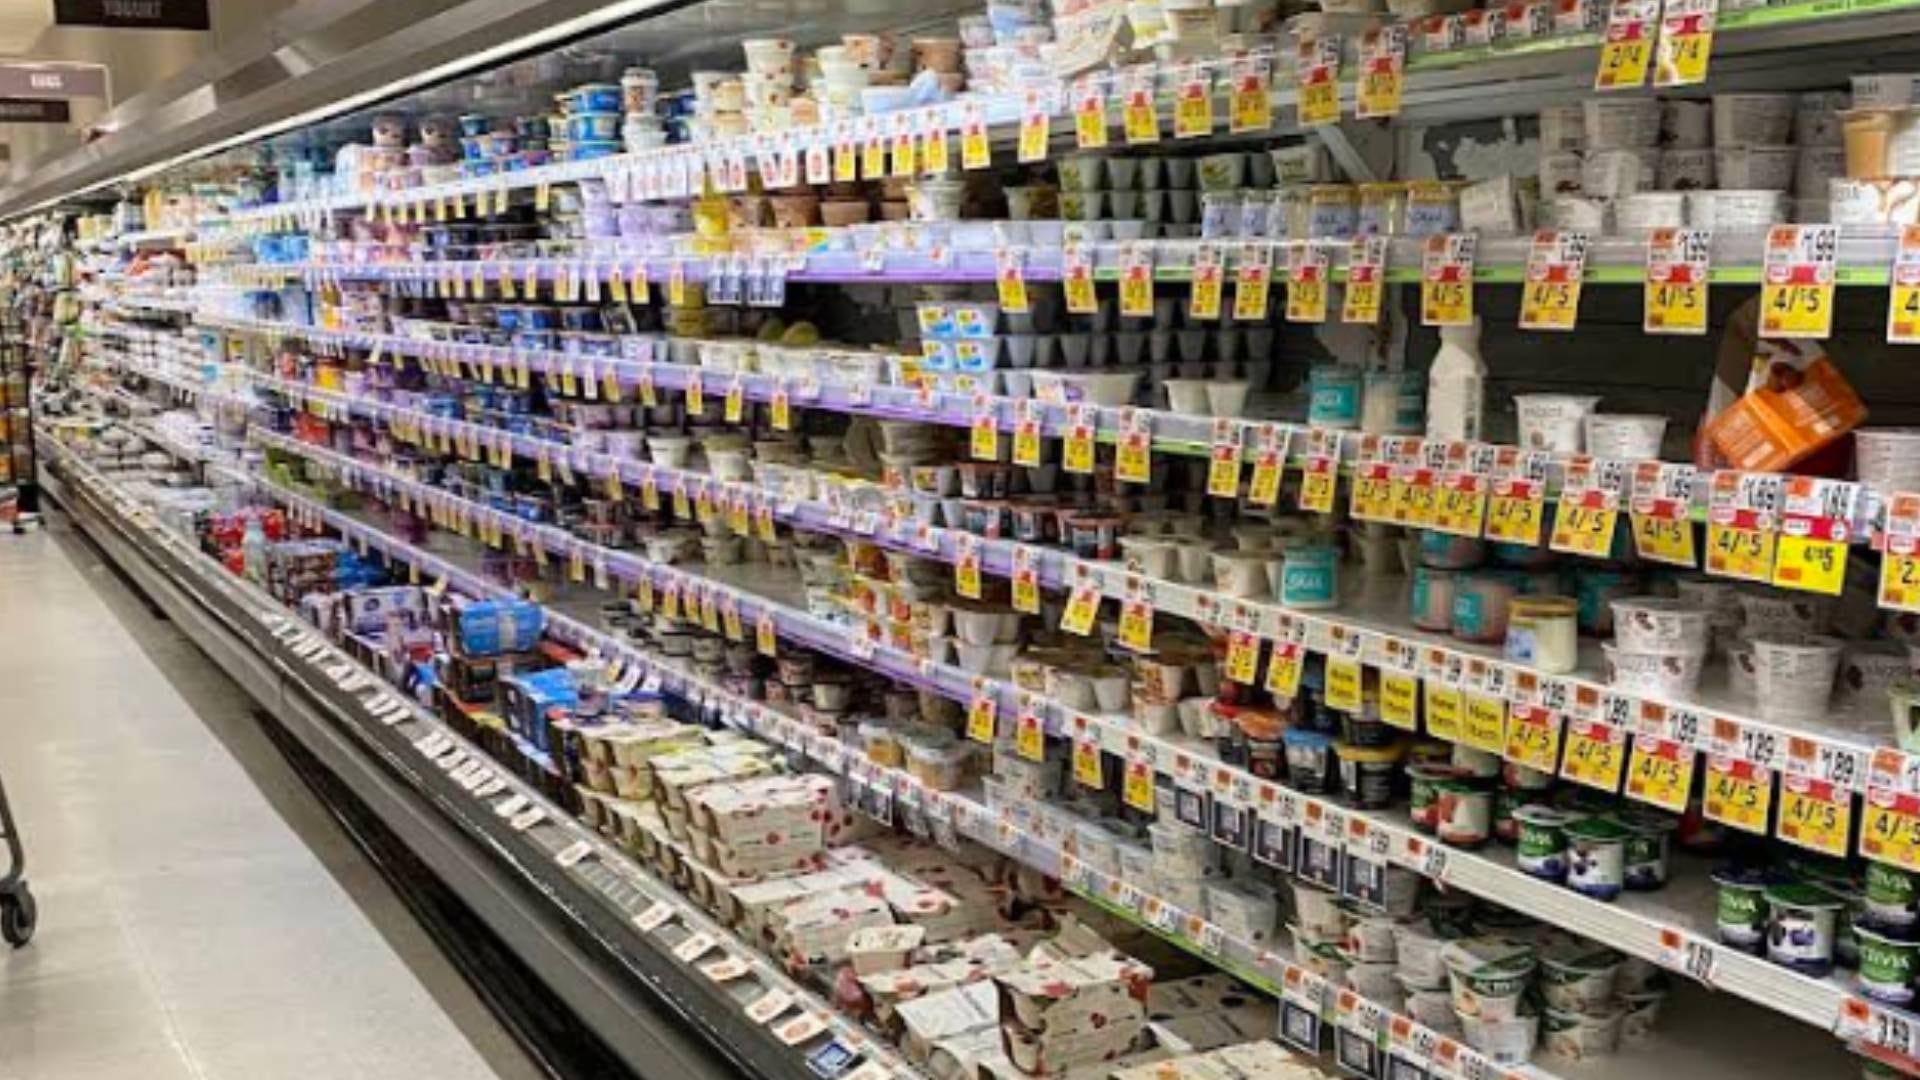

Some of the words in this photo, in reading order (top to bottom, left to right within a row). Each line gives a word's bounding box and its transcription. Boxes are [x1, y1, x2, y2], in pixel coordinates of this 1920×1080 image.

[1331, 666, 1354, 682] New
[1386, 679, 1411, 698] New
[1430, 694, 1457, 711] New
[1469, 704, 1498, 723] New
